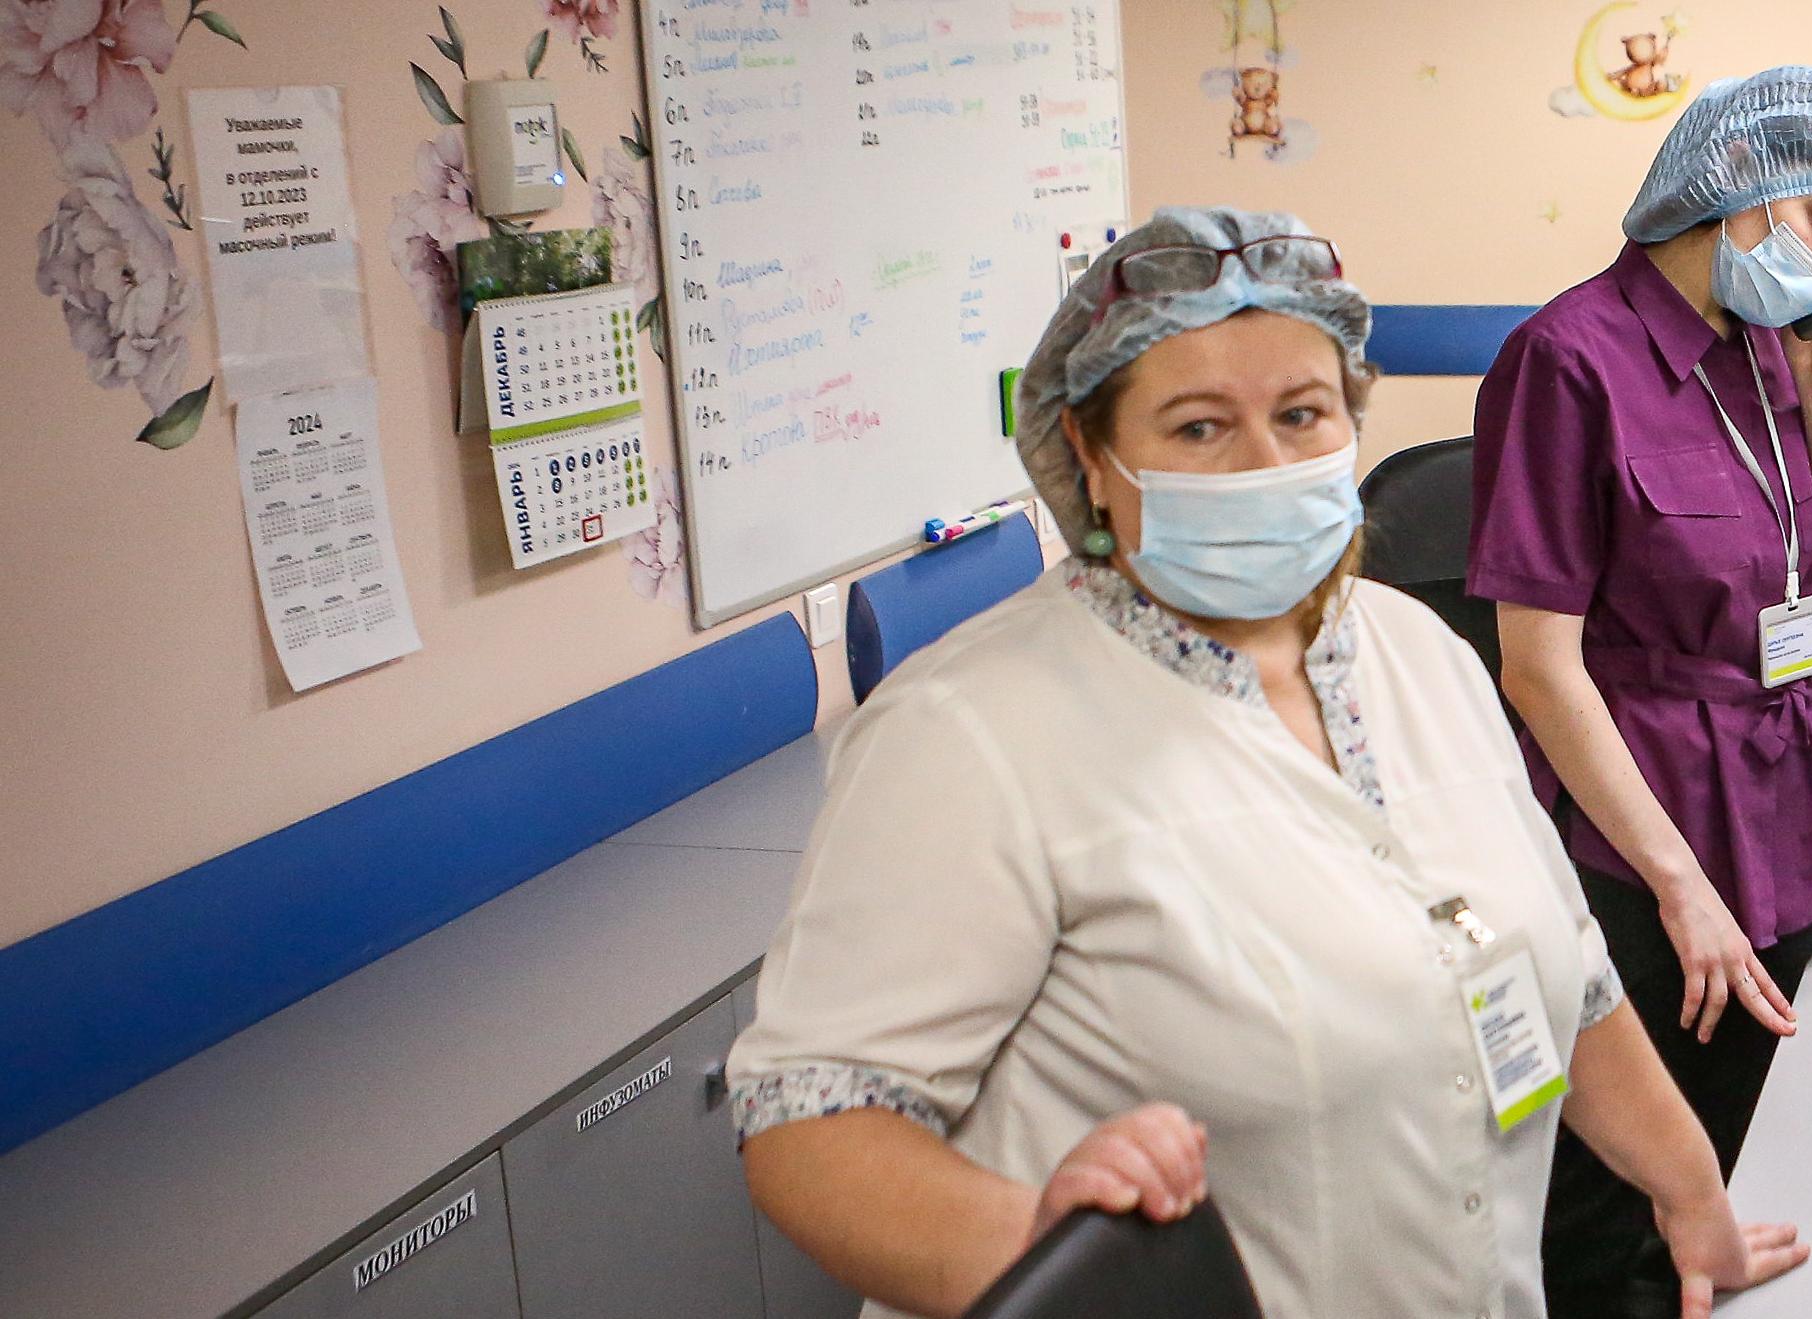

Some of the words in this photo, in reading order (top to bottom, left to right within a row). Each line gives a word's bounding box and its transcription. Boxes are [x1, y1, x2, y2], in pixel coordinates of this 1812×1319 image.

[224, 116, 303, 133] Уважаемые
[226, 173, 235, 185] в
[310, 167, 319, 179] с
[239, 187, 308, 207] 12.10.2023
[243, 210, 310, 232] действует
[219, 233, 288, 255] масочный
[290, 228, 337, 251] режим!
[493, 326, 515, 417] ДЕКАБРЬ
[287, 412, 323, 436] 2024
[509, 471, 534, 553] ЯНВАРЬ
[579, 1062, 670, 1129] ИНФУЗОМАТЫ
[357, 1196, 473, 1287] МОНИТОРЫ
